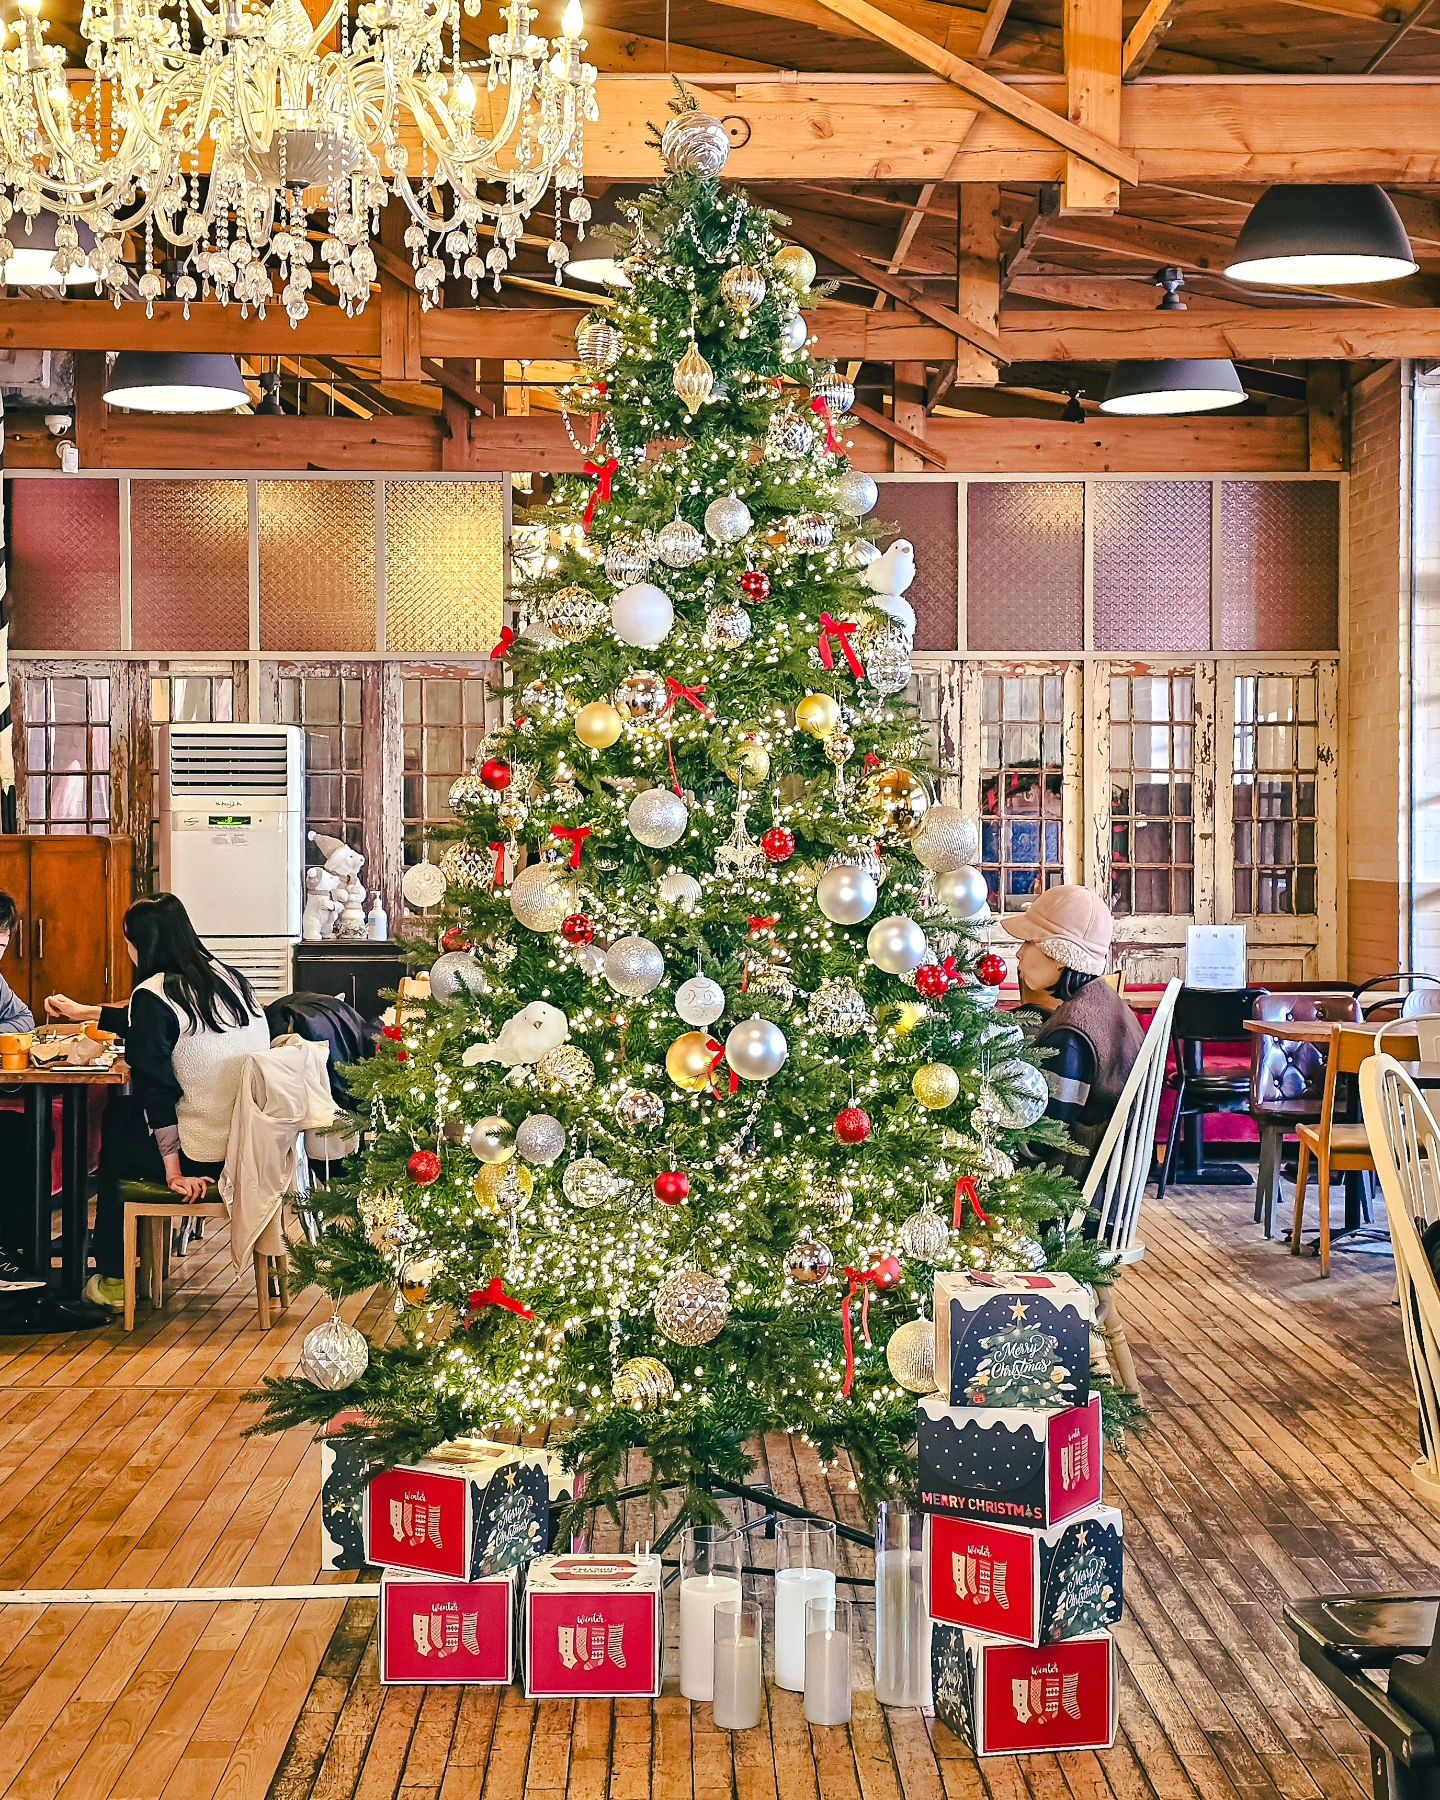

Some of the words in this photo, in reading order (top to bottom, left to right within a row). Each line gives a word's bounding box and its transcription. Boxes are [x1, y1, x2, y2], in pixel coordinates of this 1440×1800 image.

[994, 1335, 1046, 1362] Merry
[991, 1358, 1051, 1380] Christmas
[404, 1491, 427, 1503] Winter
[922, 1491, 965, 1509] MERRY
[497, 1497, 527, 1531] Merry
[495, 1518, 530, 1547] Christmas
[1067, 1557, 1098, 1592] Merry
[1065, 1580, 1102, 1610] Christmas
[432, 1602, 460, 1613] Winter
[577, 1613, 606, 1625] Winter
[1031, 1662, 1060, 1674] Winter
